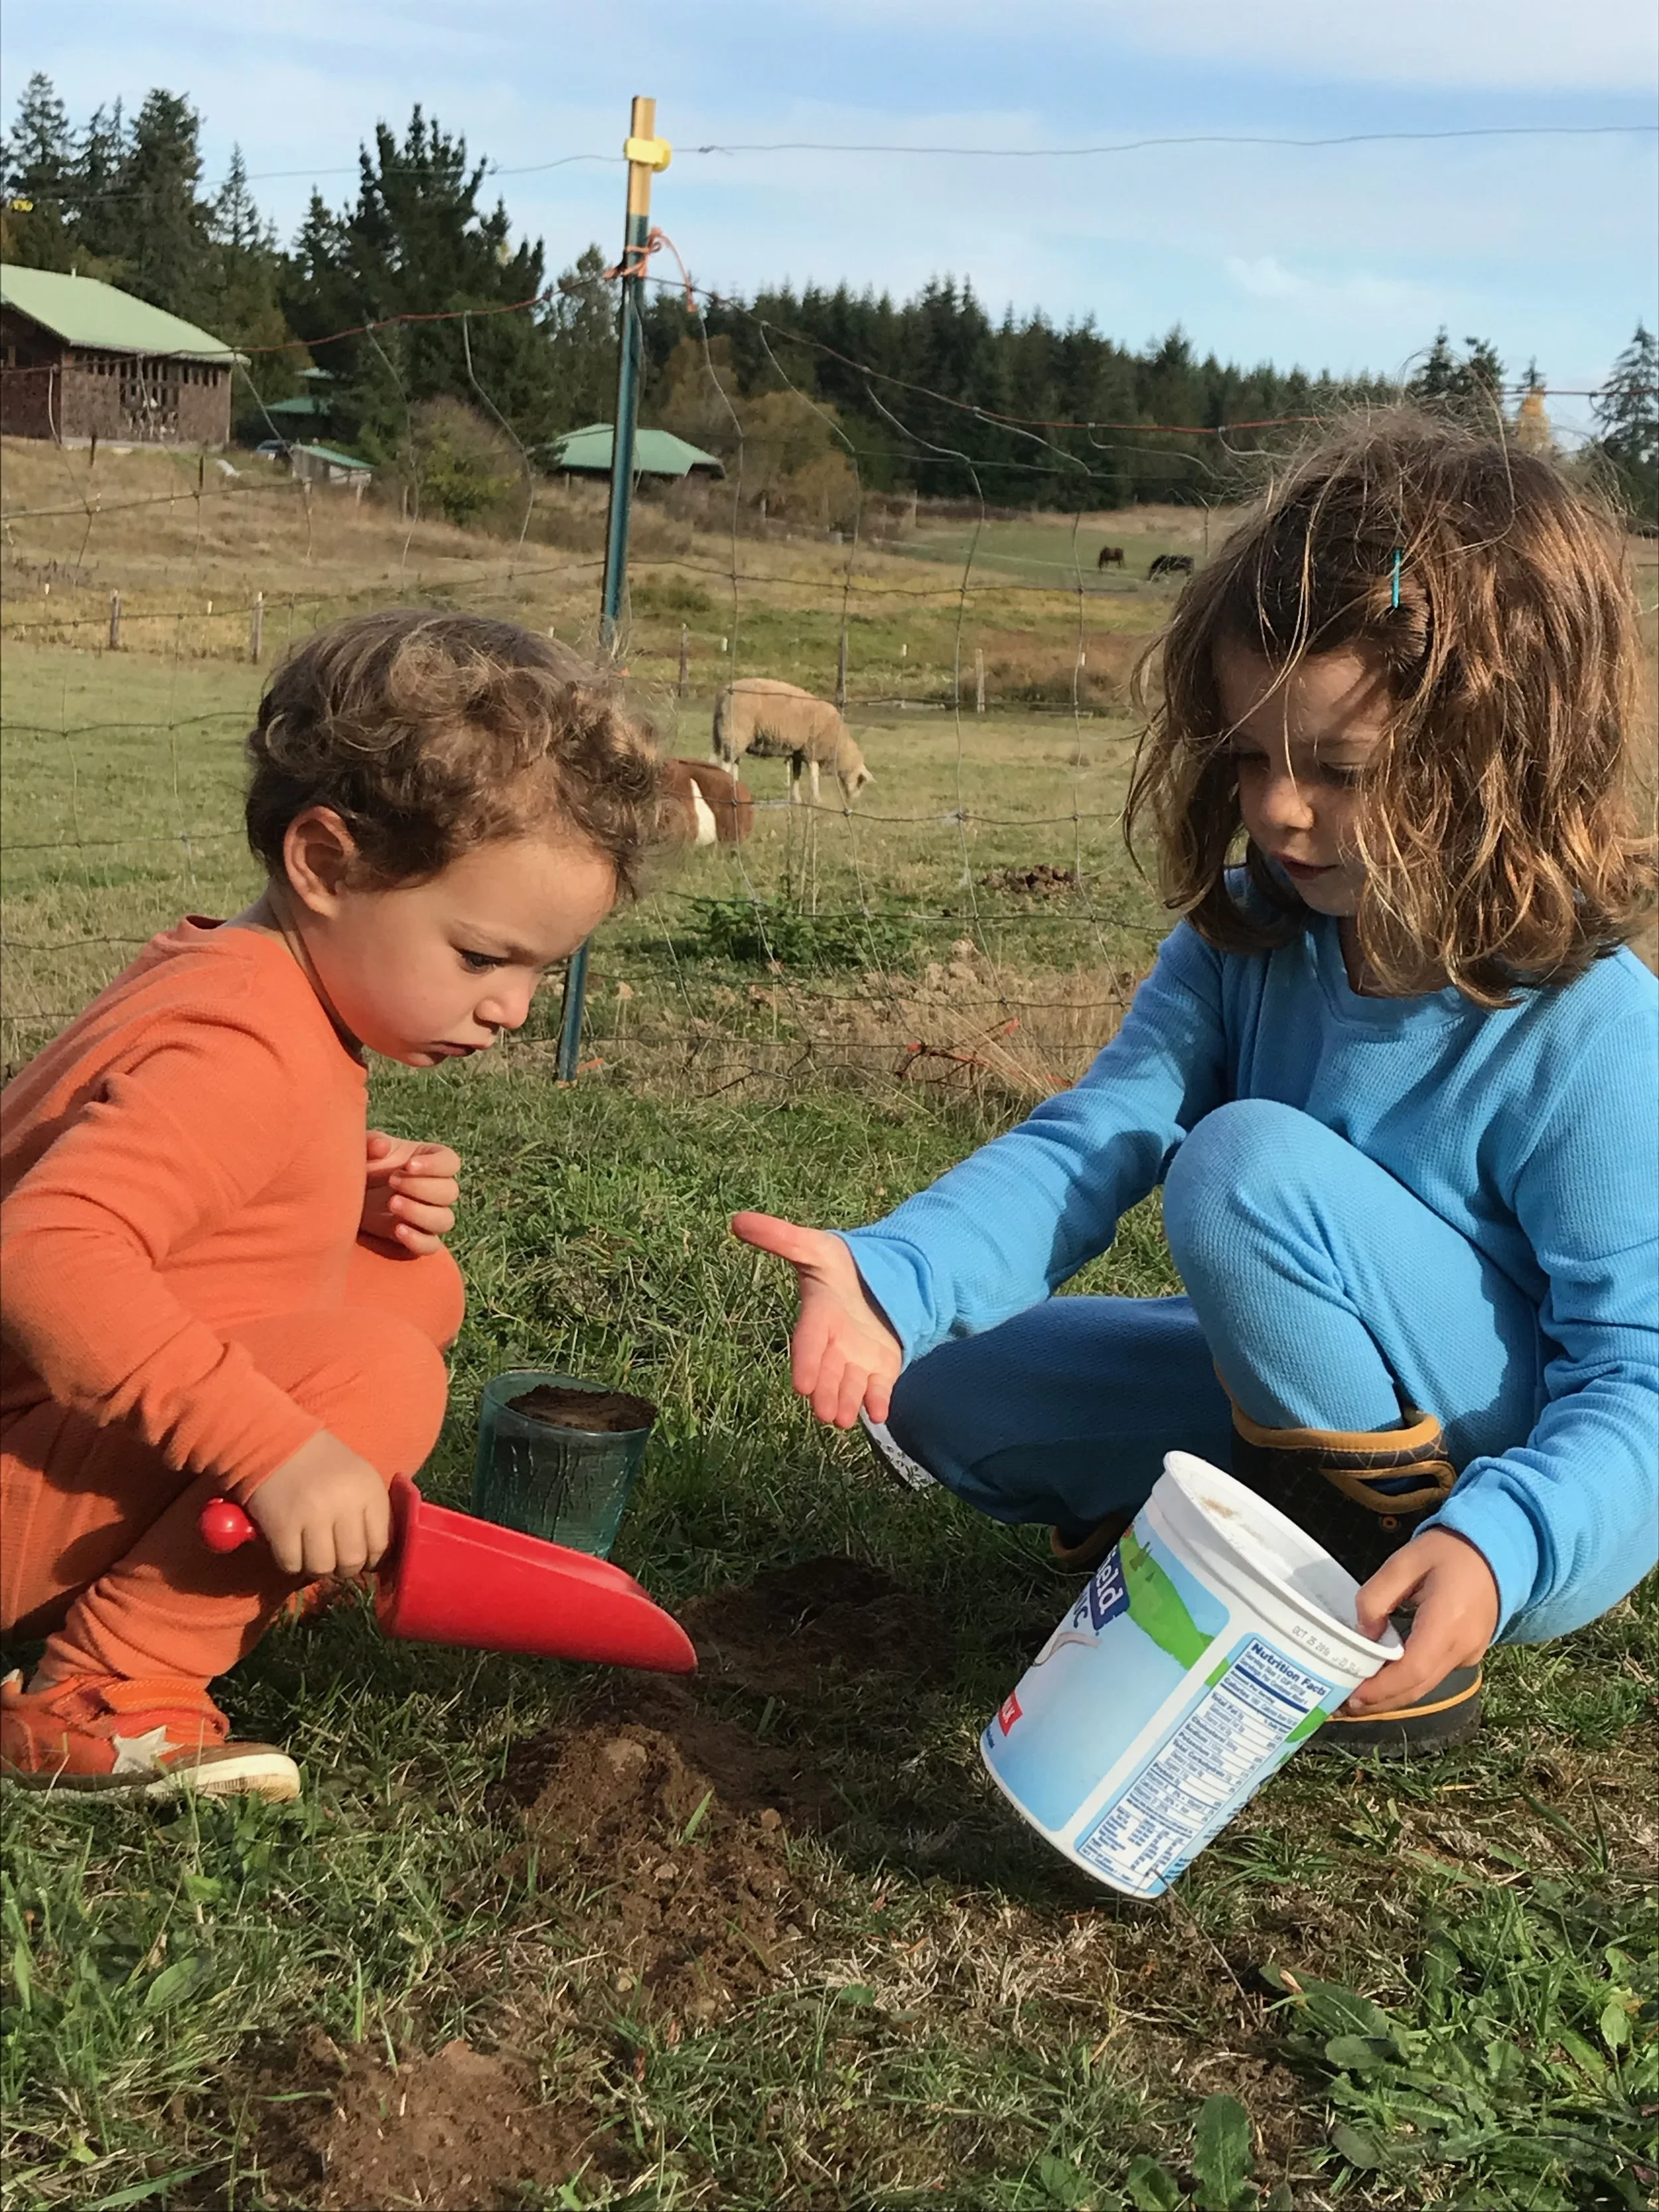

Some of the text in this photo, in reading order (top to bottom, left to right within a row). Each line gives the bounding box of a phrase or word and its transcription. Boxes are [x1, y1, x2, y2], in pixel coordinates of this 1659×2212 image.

[1244, 1651, 1265, 1670] Serving
[1250, 1642, 1302, 1682] Nutrition
[1301, 1677, 1327, 1696] Facts
[1222, 1676, 1250, 1698] Calories
[1210, 1692, 1227, 1707] Total
[1226, 1704, 1239, 1715] Fat
[1184, 1723, 1209, 1743] Sodium
[1190, 1716, 1227, 1743] Cholesterol
[1177, 1732, 1211, 1757] Potassium
[1171, 1739, 1189, 1754] Total
[1187, 1750, 1226, 1777] Carbohydrate
[1151, 1761, 1176, 1781] Protein
